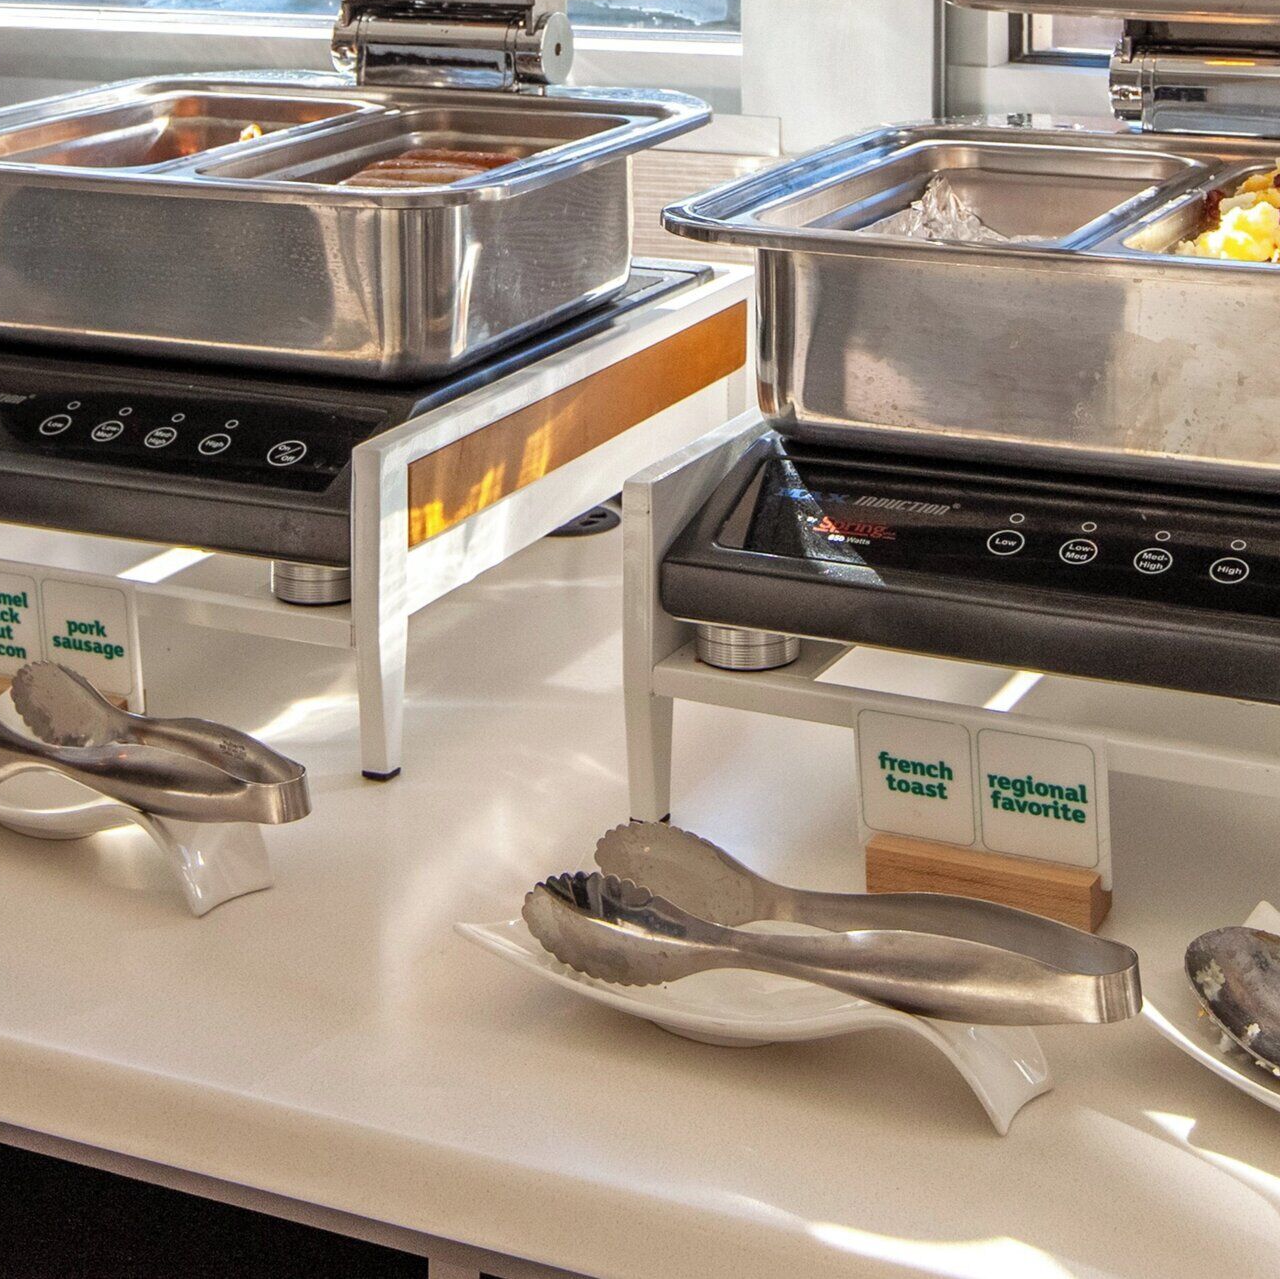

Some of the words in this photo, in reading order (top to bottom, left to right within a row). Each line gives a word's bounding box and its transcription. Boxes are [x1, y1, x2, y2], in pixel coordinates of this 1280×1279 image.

[995, 537, 1018, 547] Low
[1069, 543, 1094, 553] Low-
[1065, 551, 1088, 561] Med
[1141, 552, 1169, 561] Med-
[1139, 561, 1164, 570] High
[1217, 565, 1243, 576] High
[66, 620, 107, 638] pork
[52, 635, 124, 660] sausage
[878, 751, 953, 781] french
[886, 773, 948, 799] toast
[987, 773, 1089, 804] regional
[990, 790, 1086, 824] favorite
